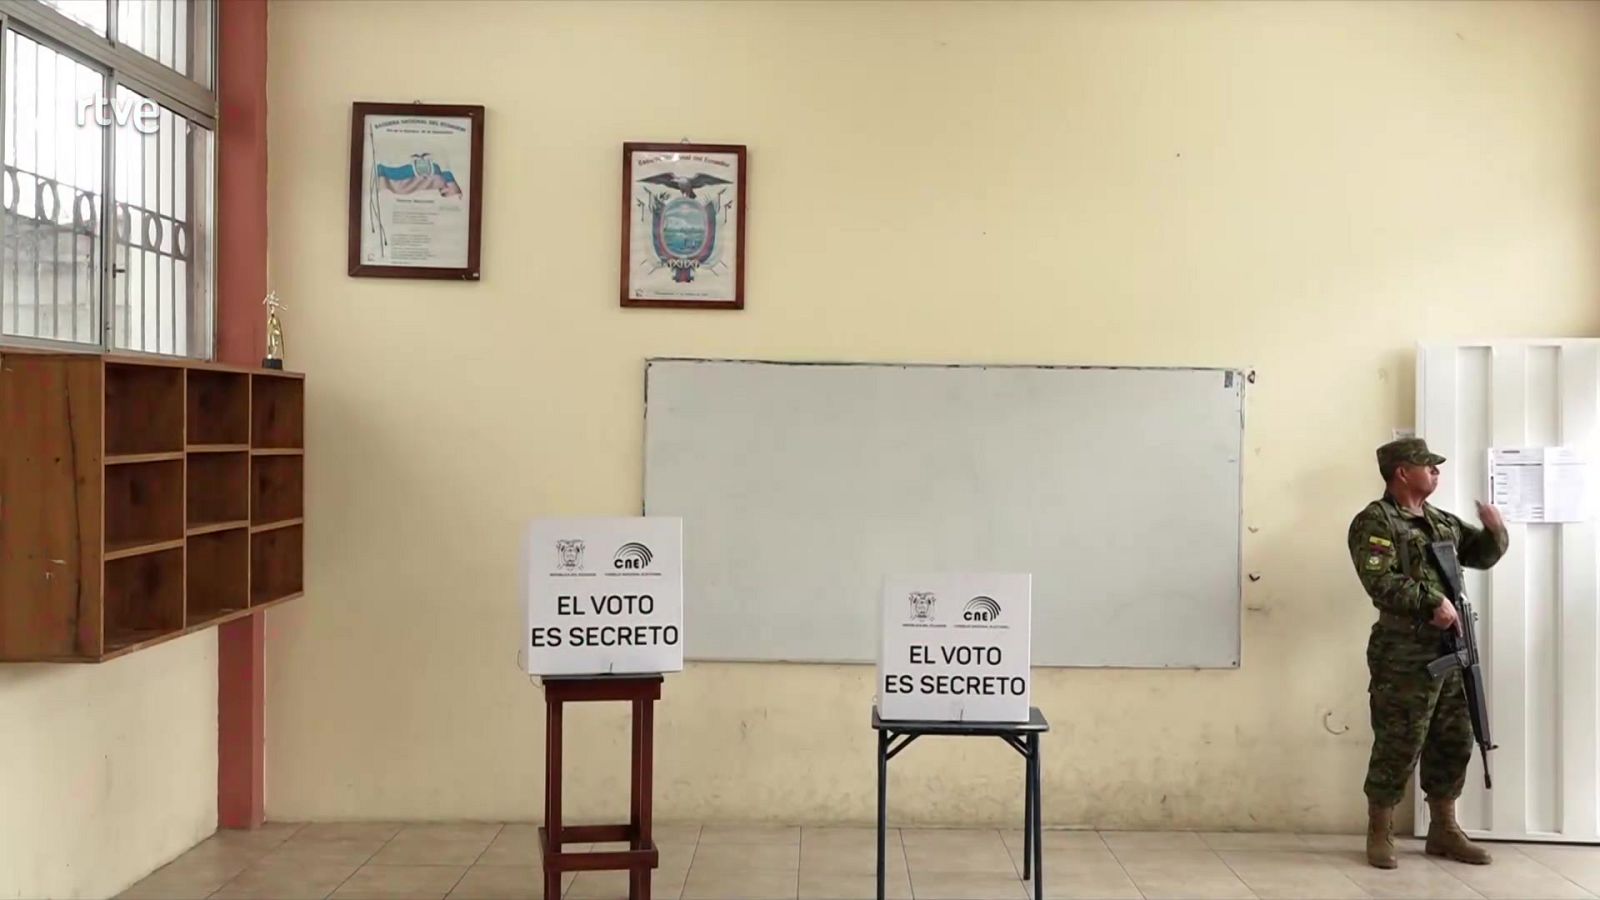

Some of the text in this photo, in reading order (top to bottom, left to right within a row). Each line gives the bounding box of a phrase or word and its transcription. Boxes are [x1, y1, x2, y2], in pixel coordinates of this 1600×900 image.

[557, 595, 654, 615] EL VOTO
[531, 625, 679, 647] ES SECRETO
[910, 645, 1002, 665] EL VOTO
[885, 675, 1026, 695] ES SECRETO
